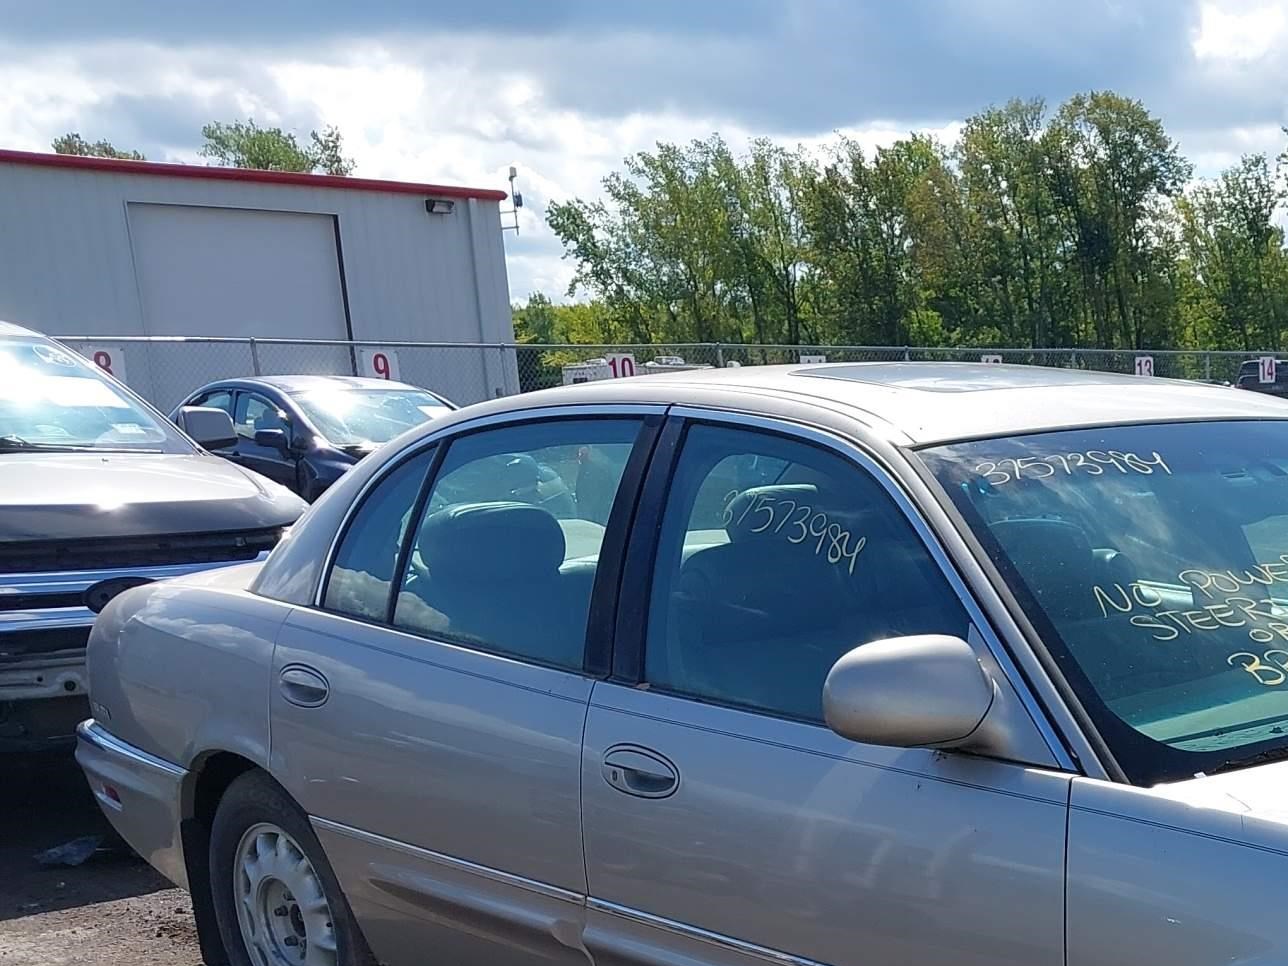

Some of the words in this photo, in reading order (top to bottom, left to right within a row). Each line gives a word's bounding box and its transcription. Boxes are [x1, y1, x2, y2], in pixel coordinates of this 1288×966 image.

[374, 353, 389, 380] 9
[608, 357, 634, 378] 10
[1261, 359, 1273, 380] 14
[975, 450, 1172, 486] 37573984
[1093, 583, 1163, 618] NO
